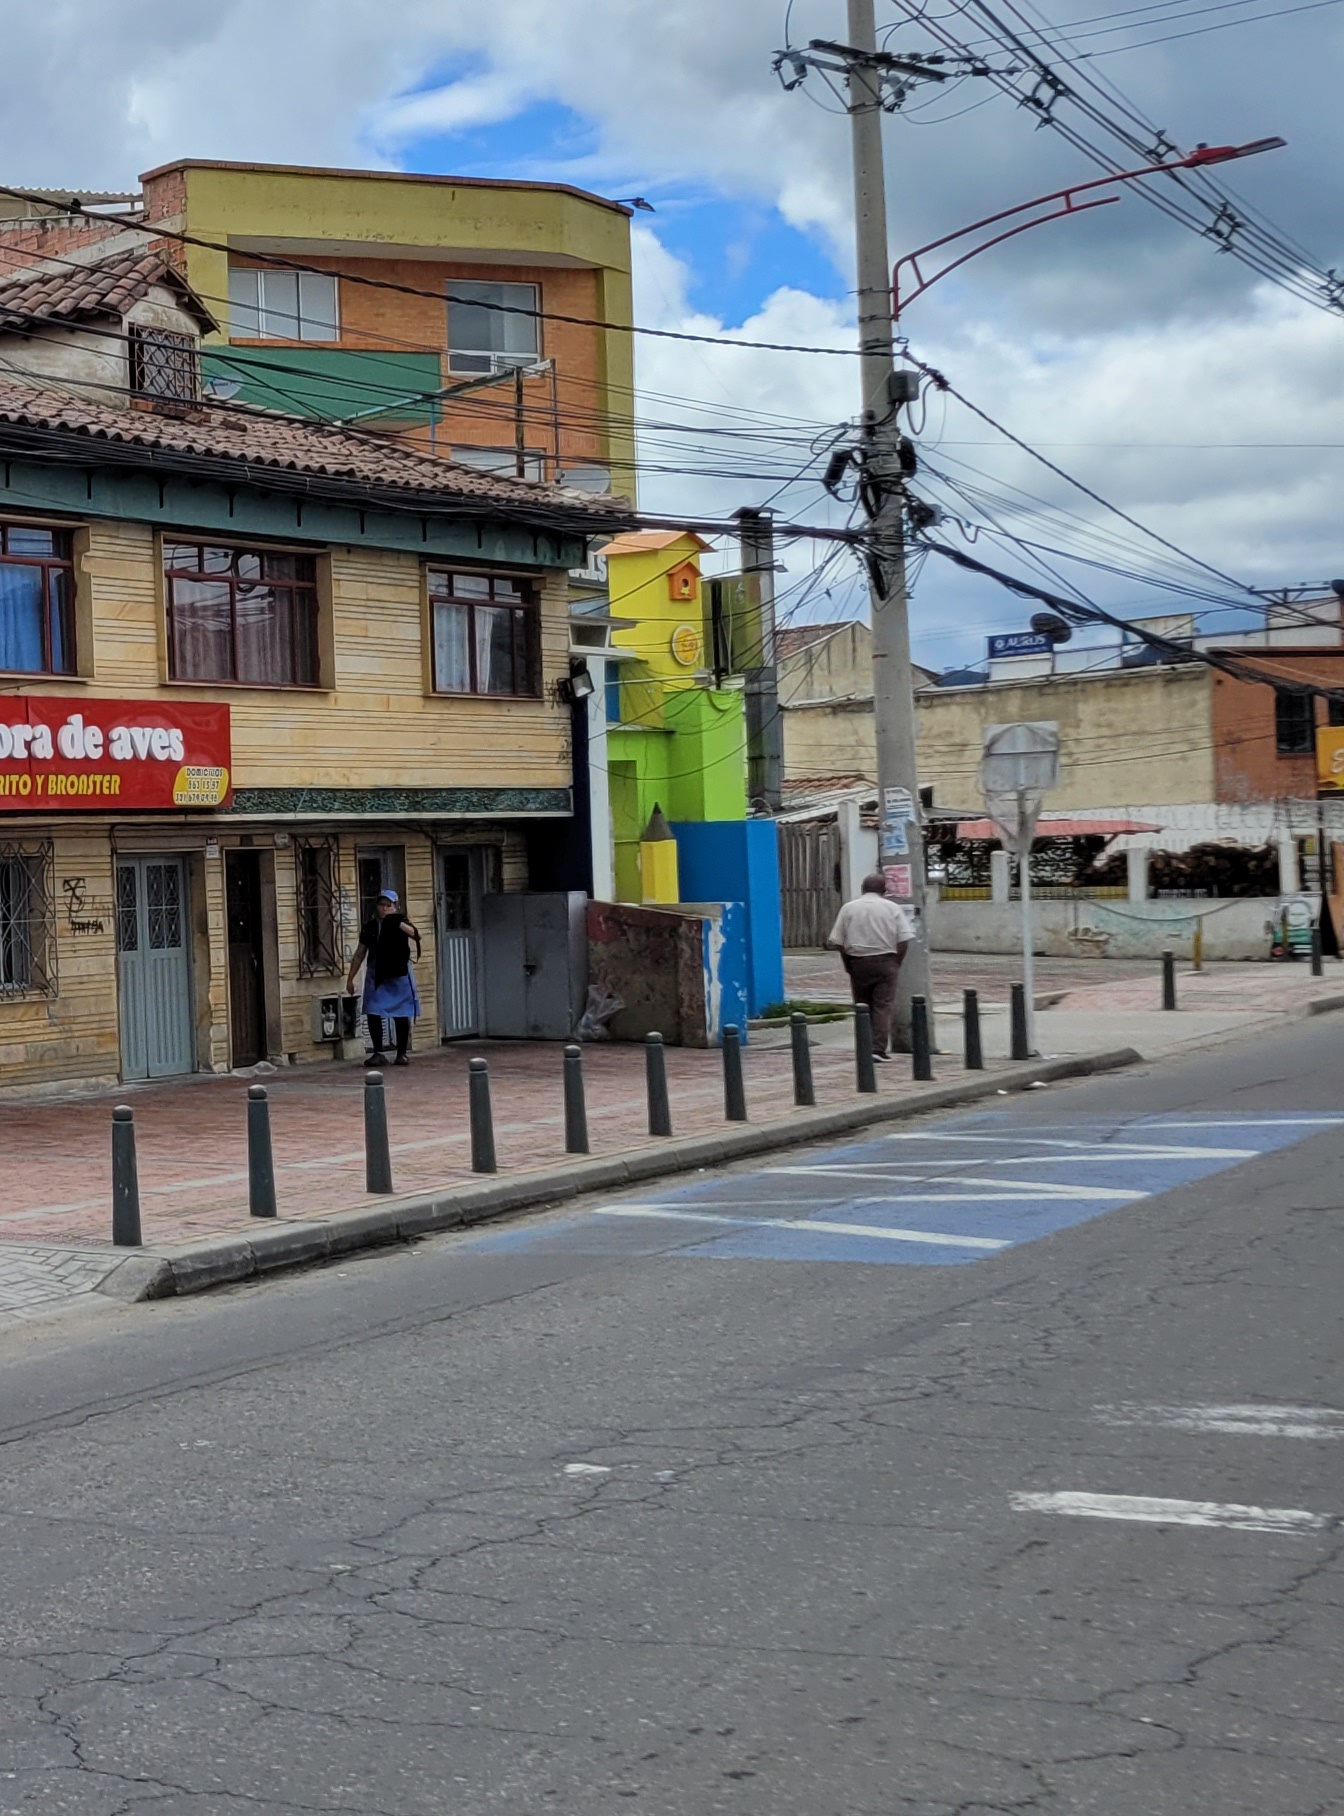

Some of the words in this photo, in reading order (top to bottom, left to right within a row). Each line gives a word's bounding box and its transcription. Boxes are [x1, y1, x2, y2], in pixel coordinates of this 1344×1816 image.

[57, 713, 104, 760] de
[108, 726, 185, 761] aves
[36, 774, 45, 796] Y
[48, 773, 121, 796] BROASTER
